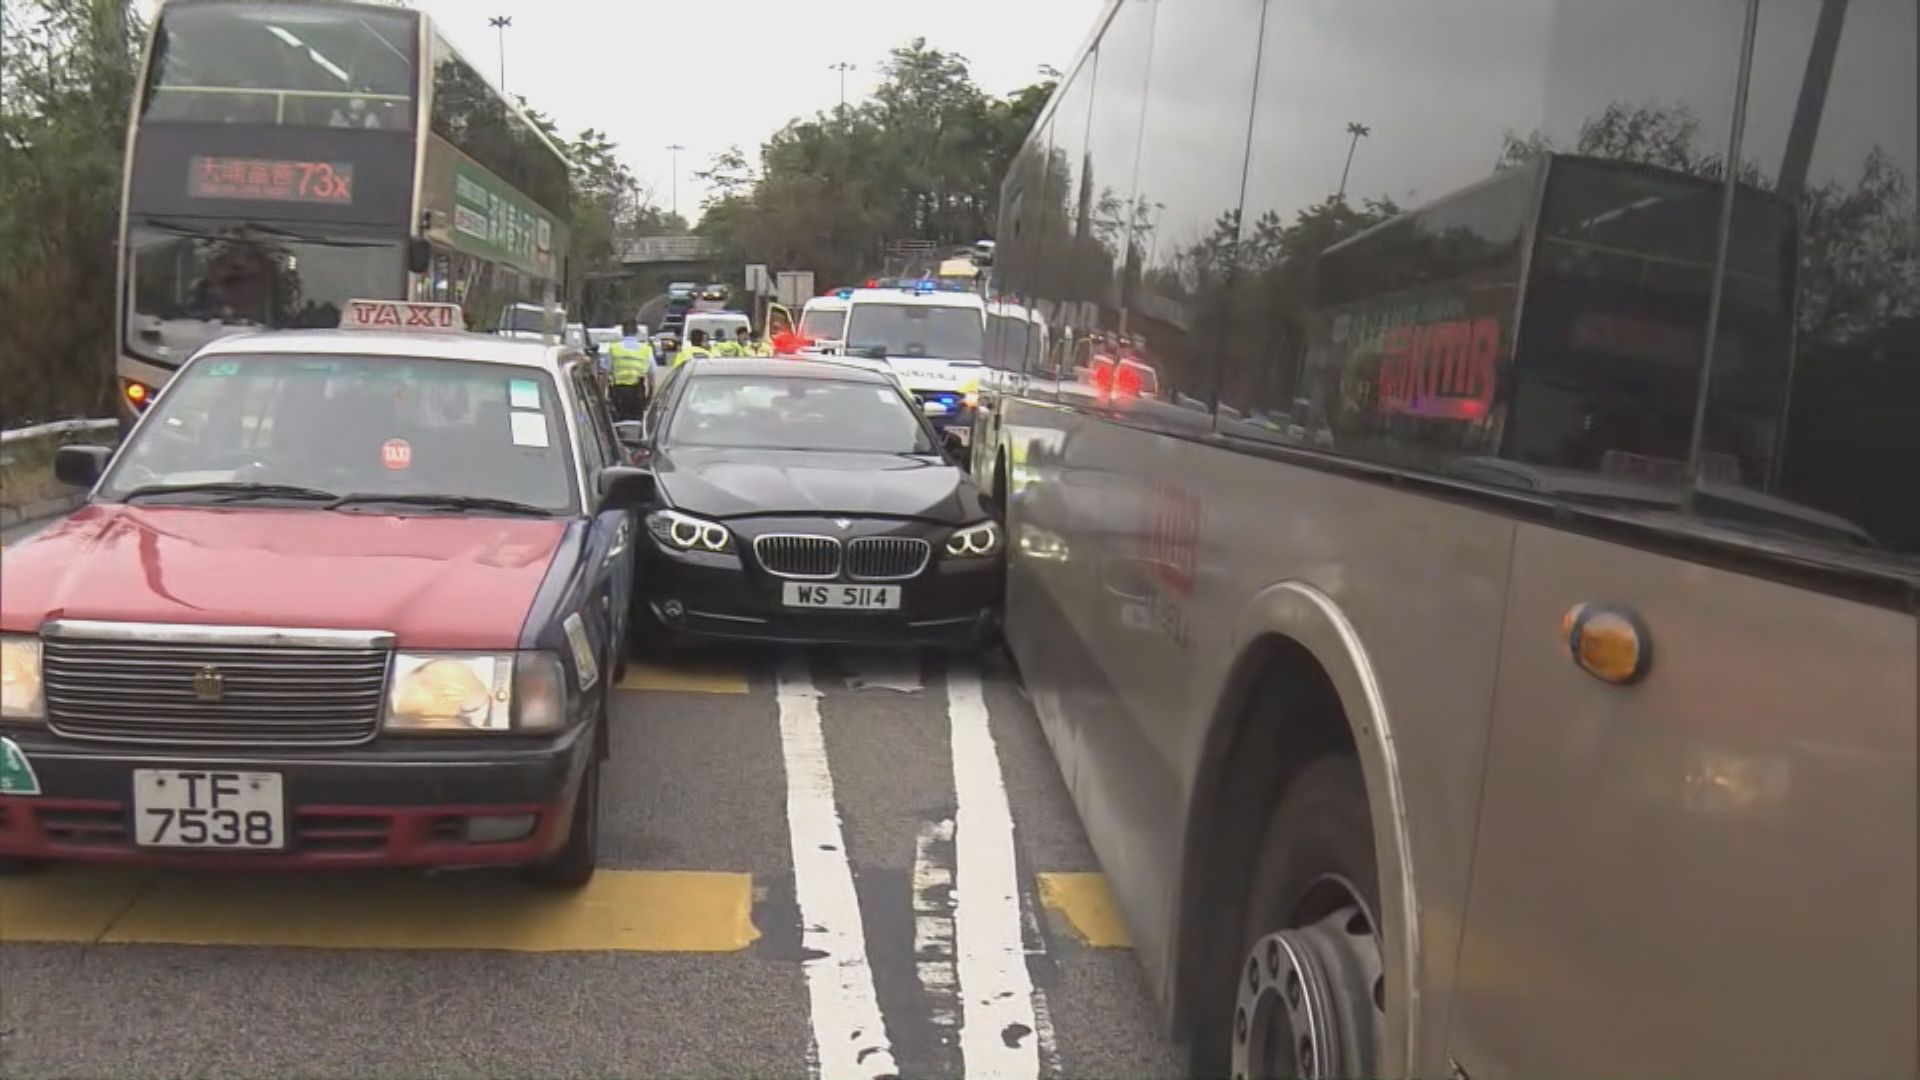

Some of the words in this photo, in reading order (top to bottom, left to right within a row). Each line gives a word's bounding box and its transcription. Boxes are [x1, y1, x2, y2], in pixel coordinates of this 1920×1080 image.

[352, 303, 452, 327] TAXI
[798, 586, 829, 605] WS
[842, 587, 888, 607] 5114
[177, 772, 240, 809] TF
[146, 808, 273, 845] 7538
